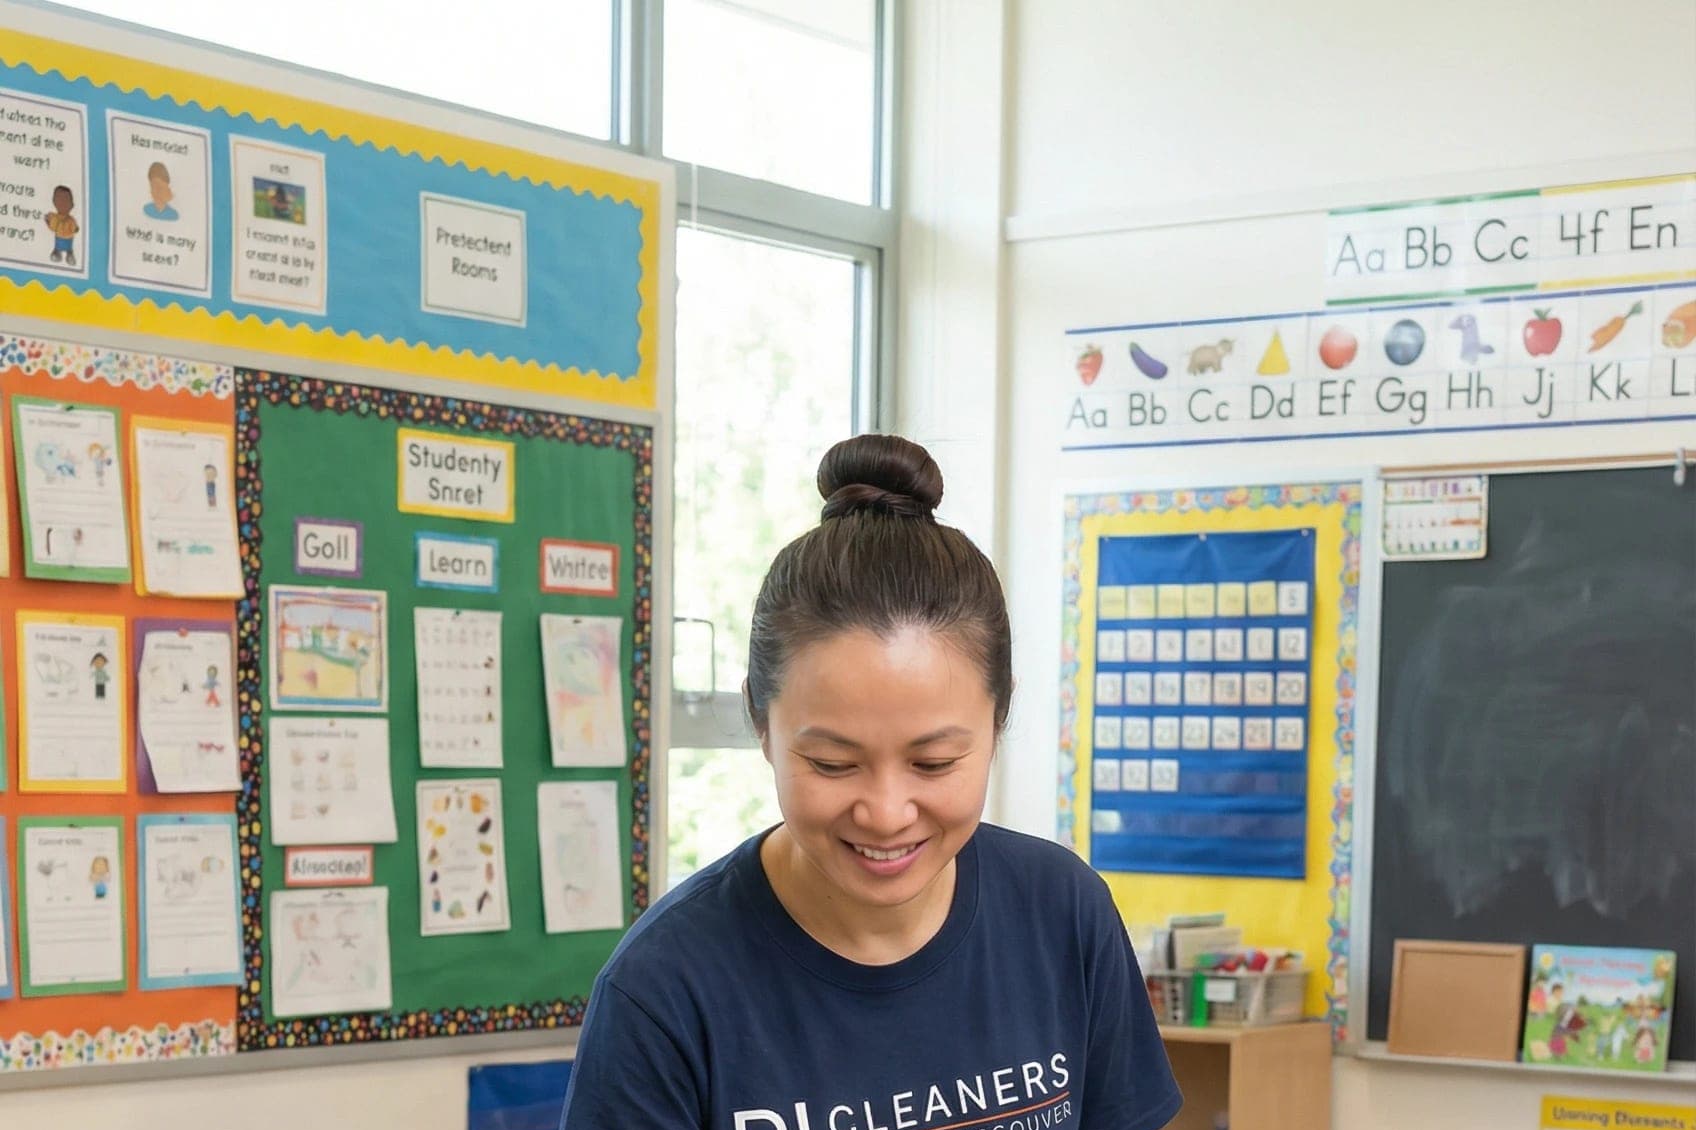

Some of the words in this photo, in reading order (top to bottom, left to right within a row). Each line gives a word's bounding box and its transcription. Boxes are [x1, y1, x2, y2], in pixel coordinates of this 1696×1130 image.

[1332, 234, 1385, 276] Aa
[1405, 225, 1452, 269] Bb
[1474, 218, 1529, 262] Cc
[1629, 204, 1678, 250] En
[451, 256, 498, 282] Rooms
[1066, 396, 1108, 430] Aa
[1128, 392, 1167, 427] Bb
[1187, 388, 1230, 423] Cc
[1250, 381, 1296, 420] Dd
[1318, 379, 1356, 417] Ef
[1375, 376, 1428, 425] Gg
[1447, 370, 1494, 411] Hh
[1522, 367, 1556, 419] Jj
[1589, 361, 1632, 402] Kk
[408, 443, 502, 482] Studenty
[429, 551, 487, 577] Learn
